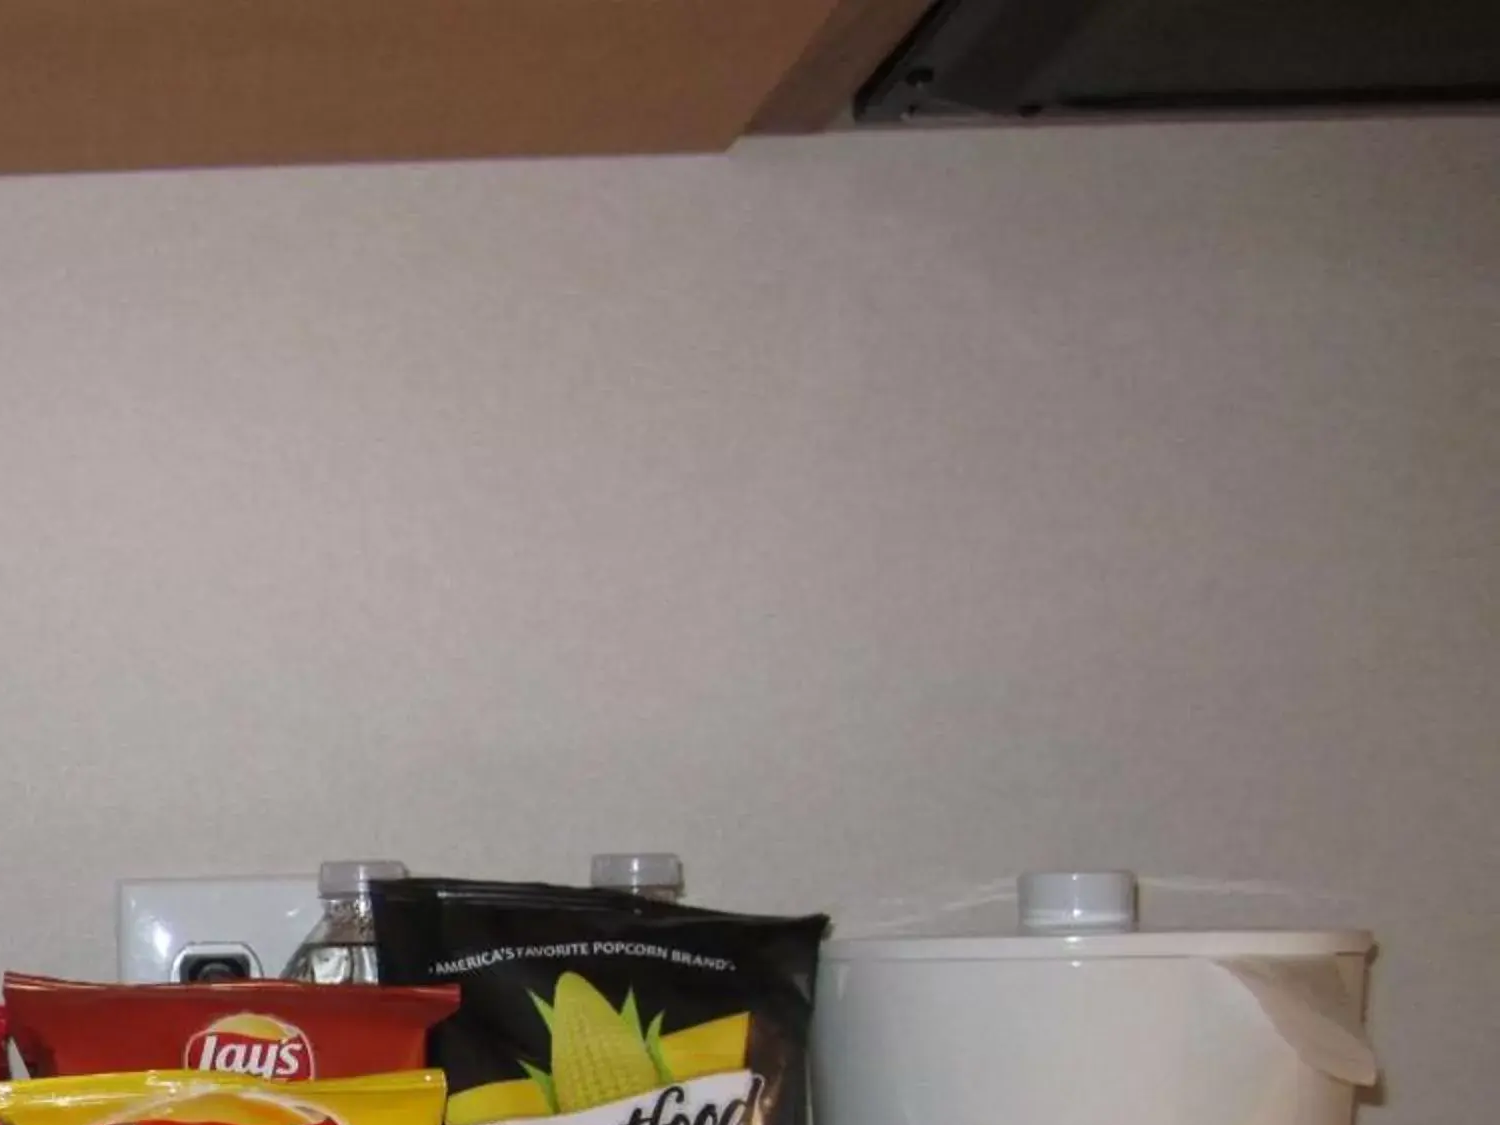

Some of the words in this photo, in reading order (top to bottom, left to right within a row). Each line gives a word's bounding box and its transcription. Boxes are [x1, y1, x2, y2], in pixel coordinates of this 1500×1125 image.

[436, 947, 515, 974] AMERICA'S
[516, 942, 589, 959] FAVORITE
[593, 941, 668, 960] POPCORN
[200, 1035, 302, 1080] Lay's
